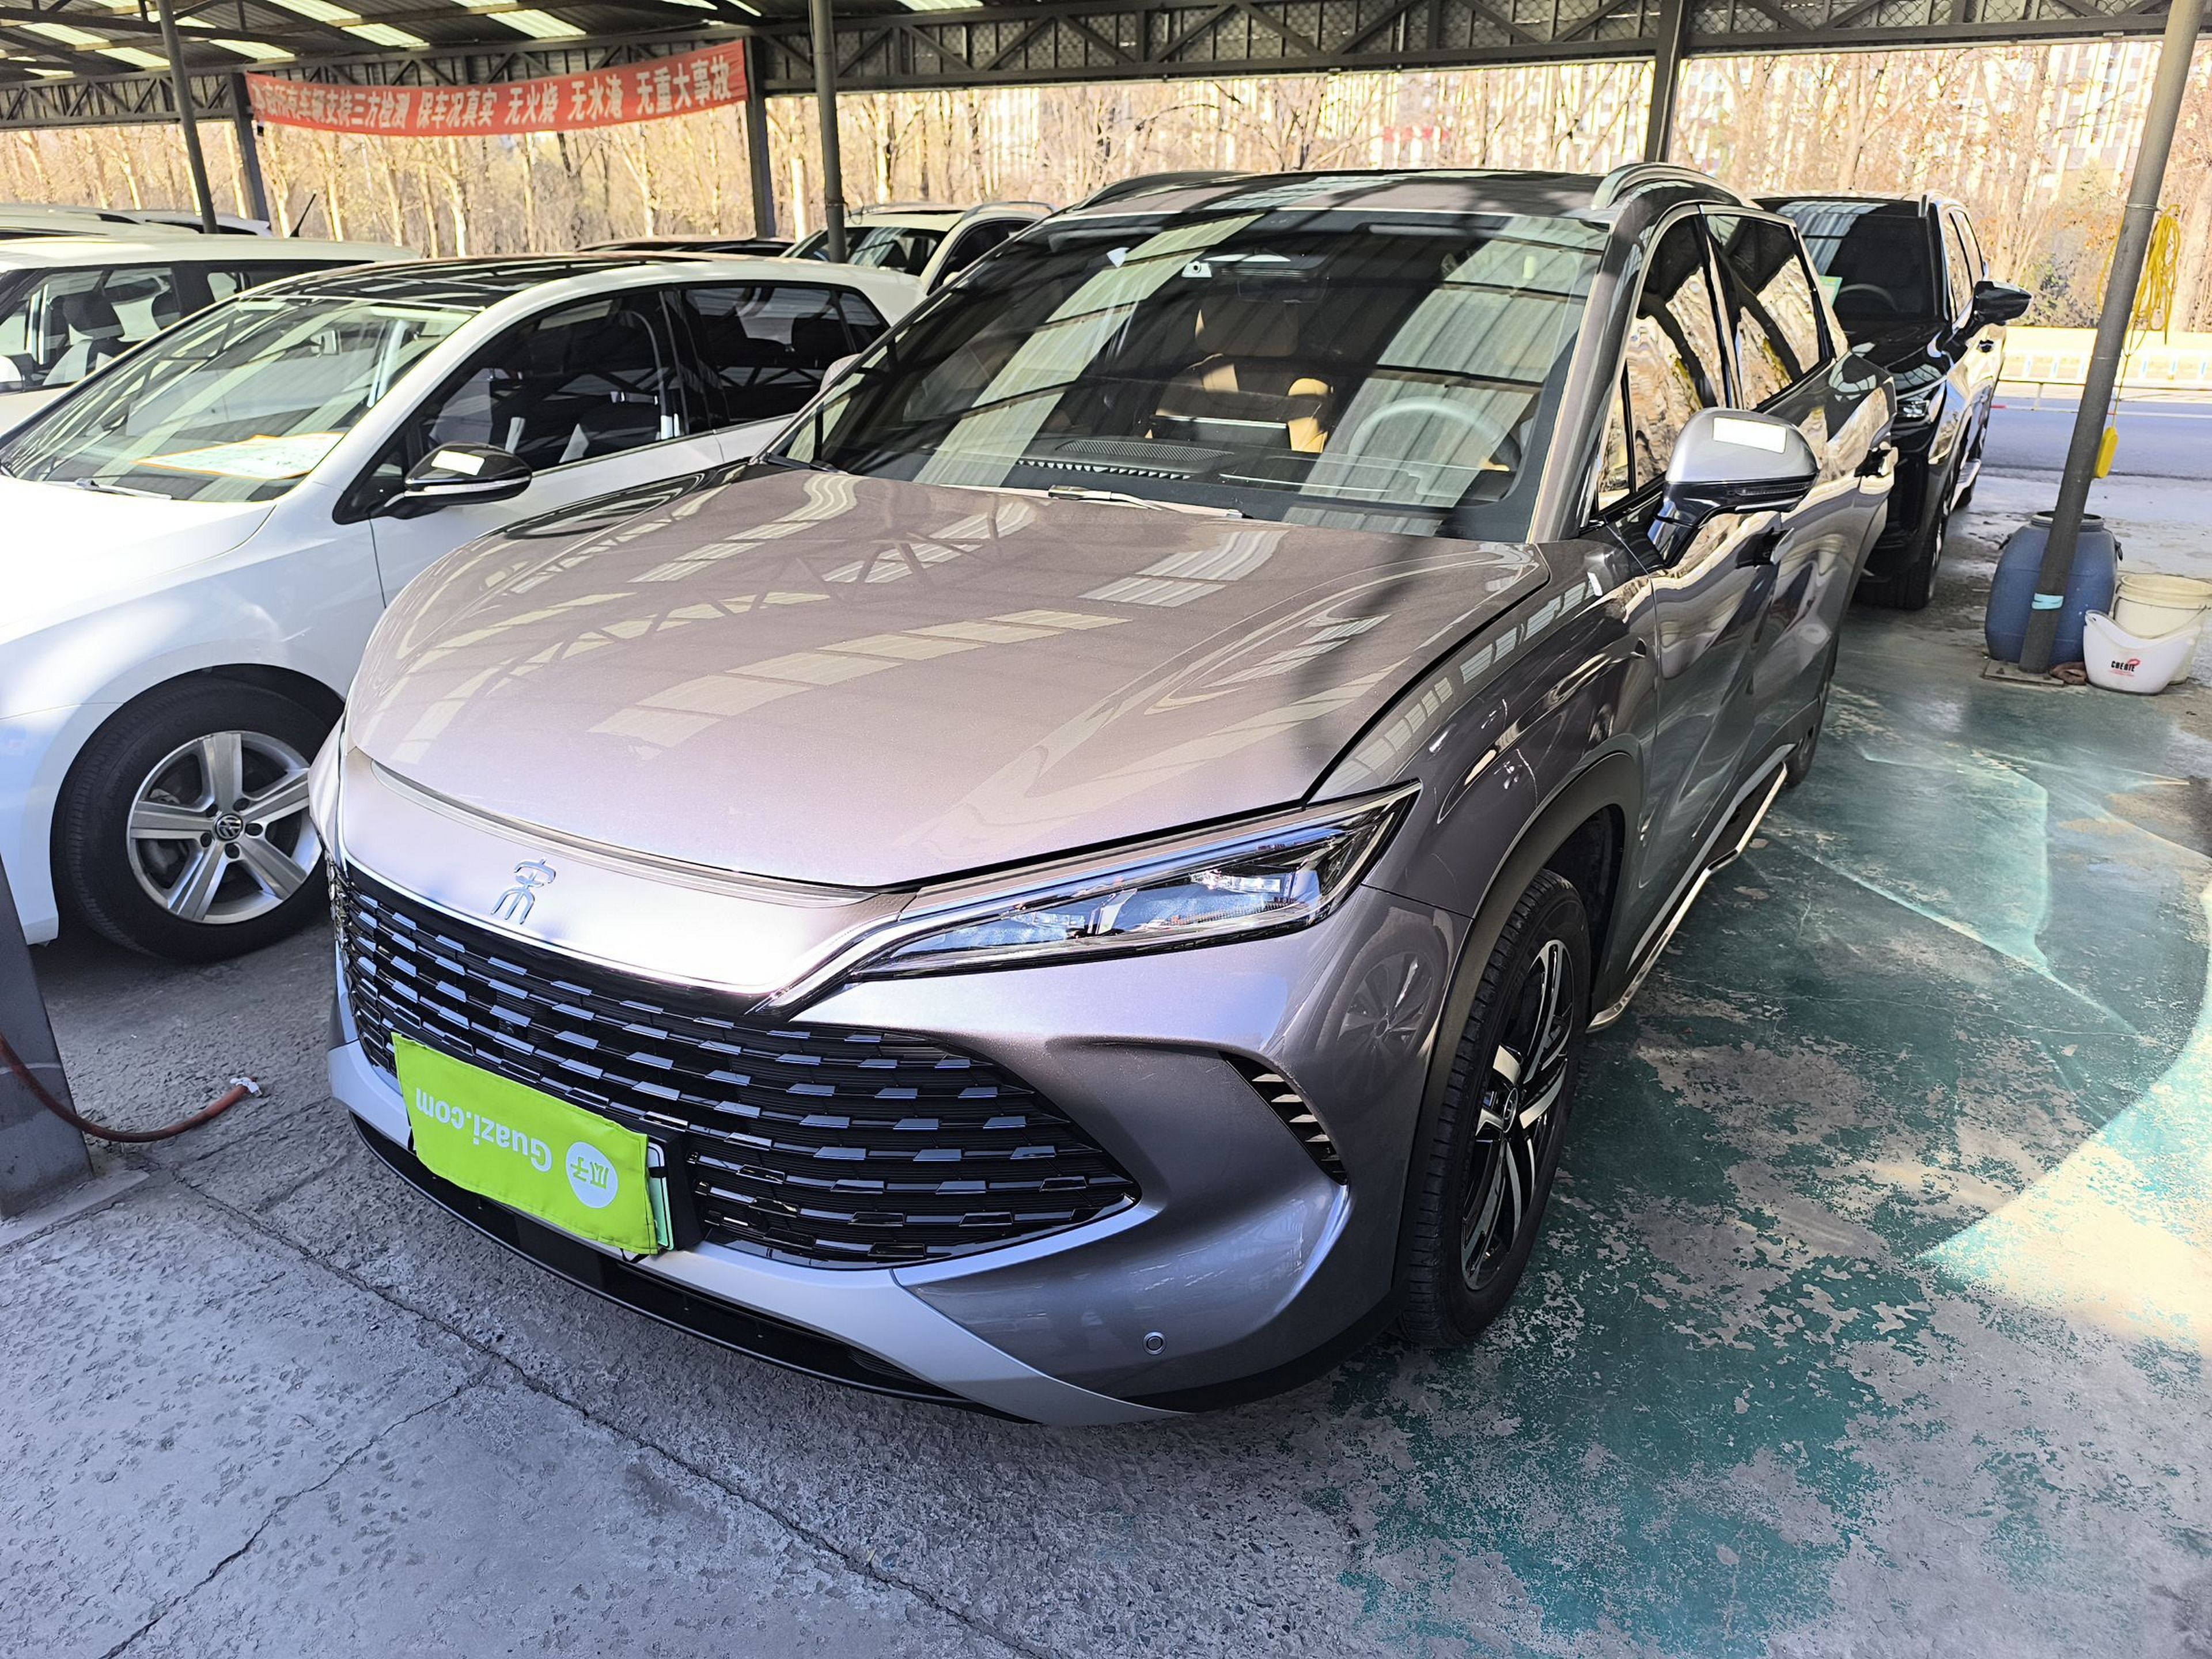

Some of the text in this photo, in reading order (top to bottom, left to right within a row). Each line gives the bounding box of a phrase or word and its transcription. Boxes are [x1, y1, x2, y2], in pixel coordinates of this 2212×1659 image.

[417, 88, 497, 128] 保车况真实
[504, 82, 558, 124] 无火烧
[636, 54, 732, 115] 无重大事故
[416, 1088, 552, 1172] Guazi.com
[570, 1156, 609, 1190] 瓜子
